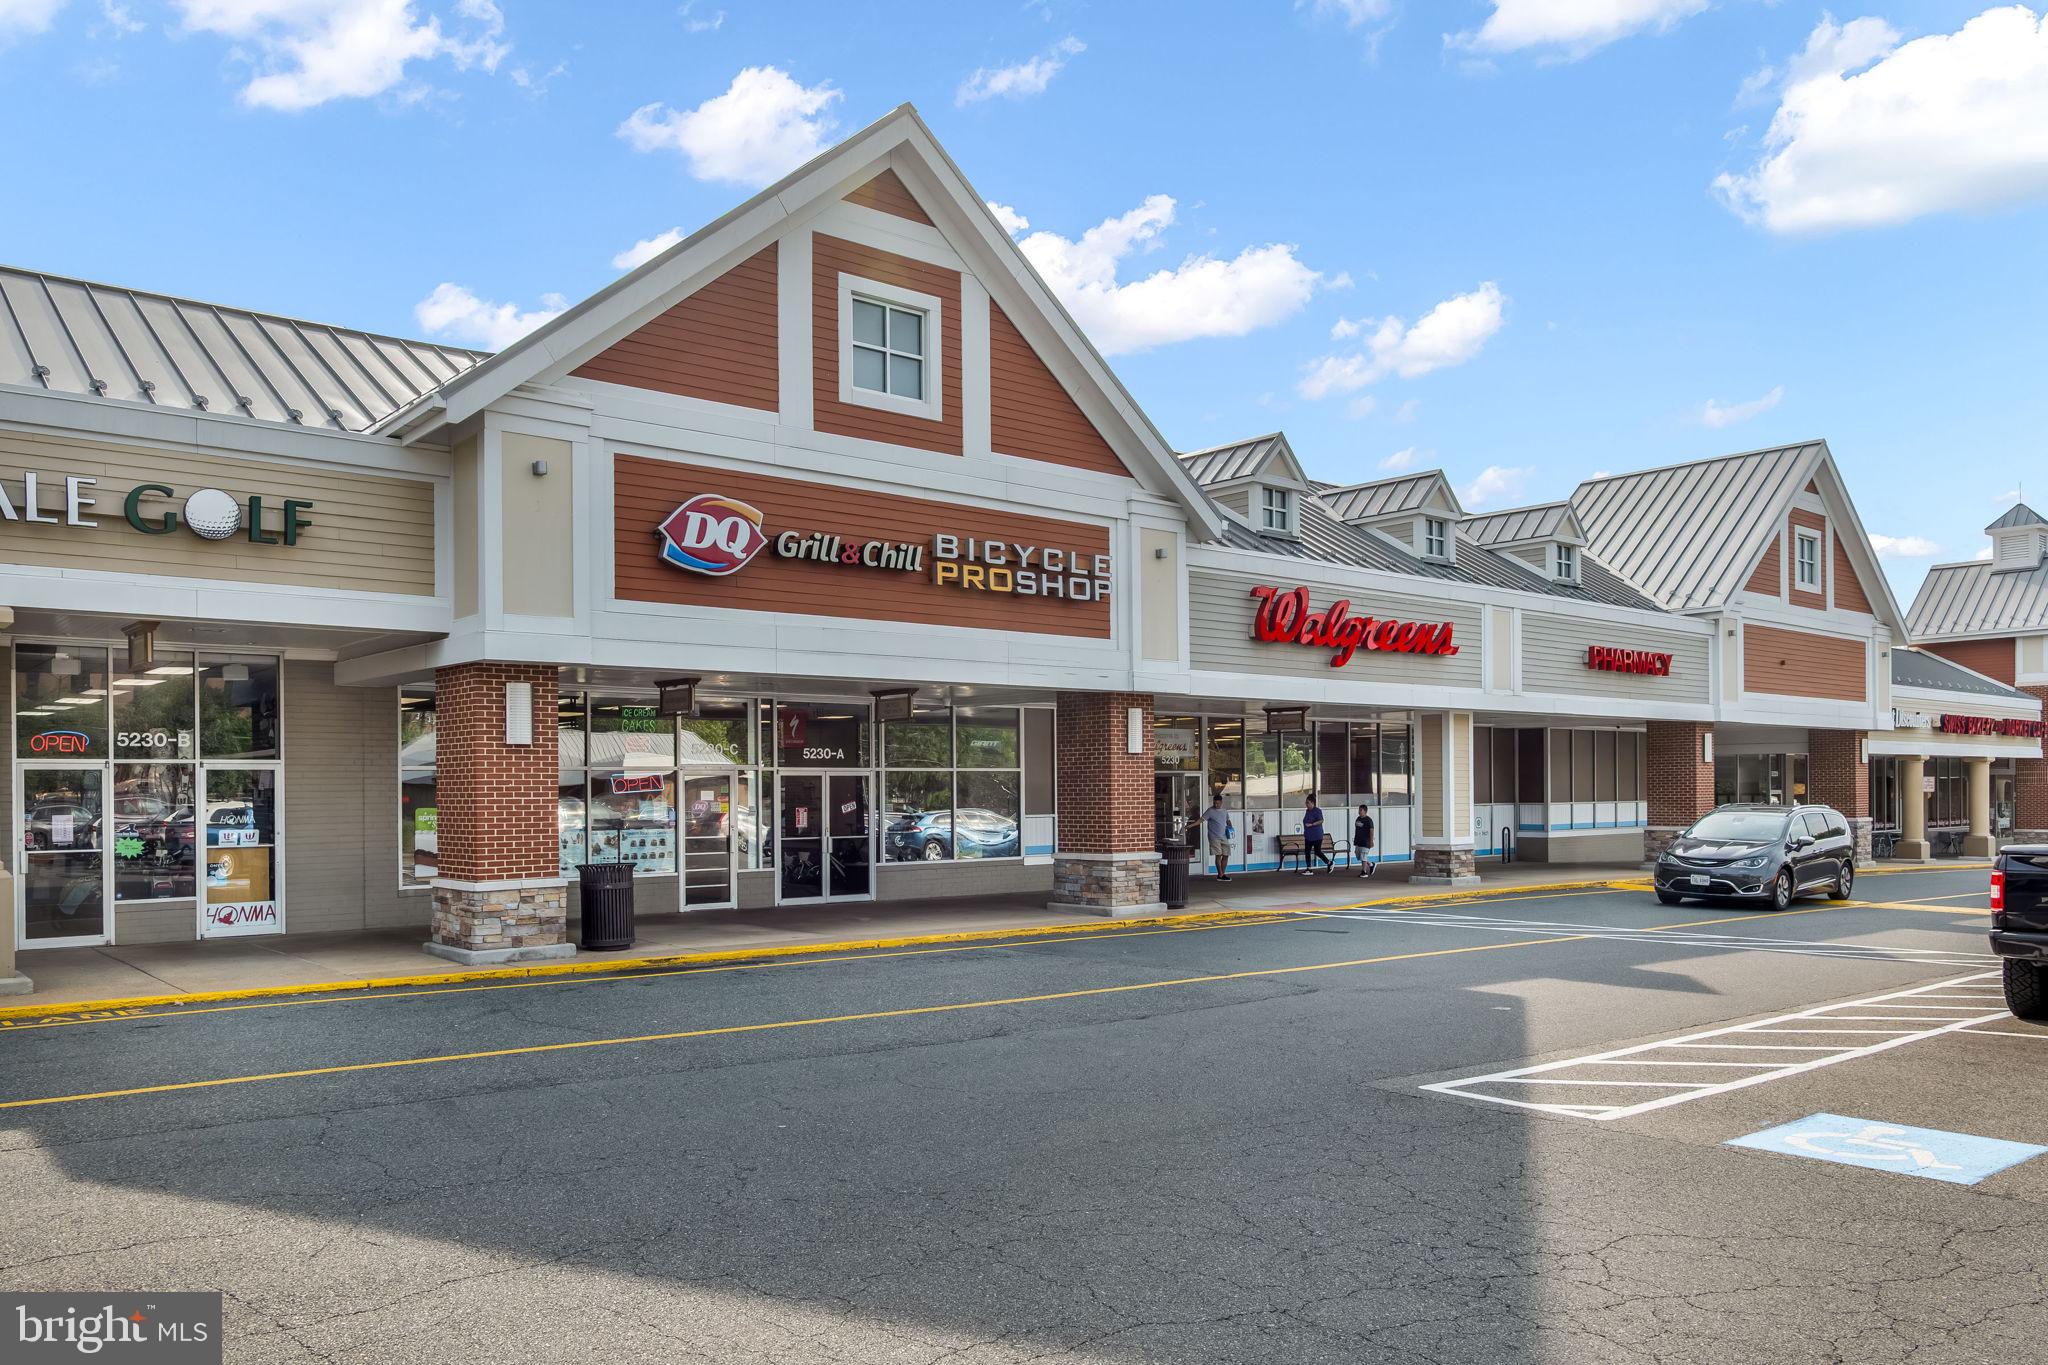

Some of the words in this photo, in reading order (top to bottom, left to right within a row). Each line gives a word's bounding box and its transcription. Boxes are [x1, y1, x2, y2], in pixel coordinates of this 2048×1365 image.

[681, 510, 752, 560] DQ
[936, 533, 1113, 578] BICYCLE
[1249, 584, 1462, 667] Walgreens
[1587, 645, 1674, 677] PHARMACY
[30, 734, 87, 752] OPEN
[117, 732, 191, 748] 5230-B
[803, 748, 845, 759] 5230-A
[1161, 755, 1180, 764] 5230
[613, 775, 663, 793] OPEN
